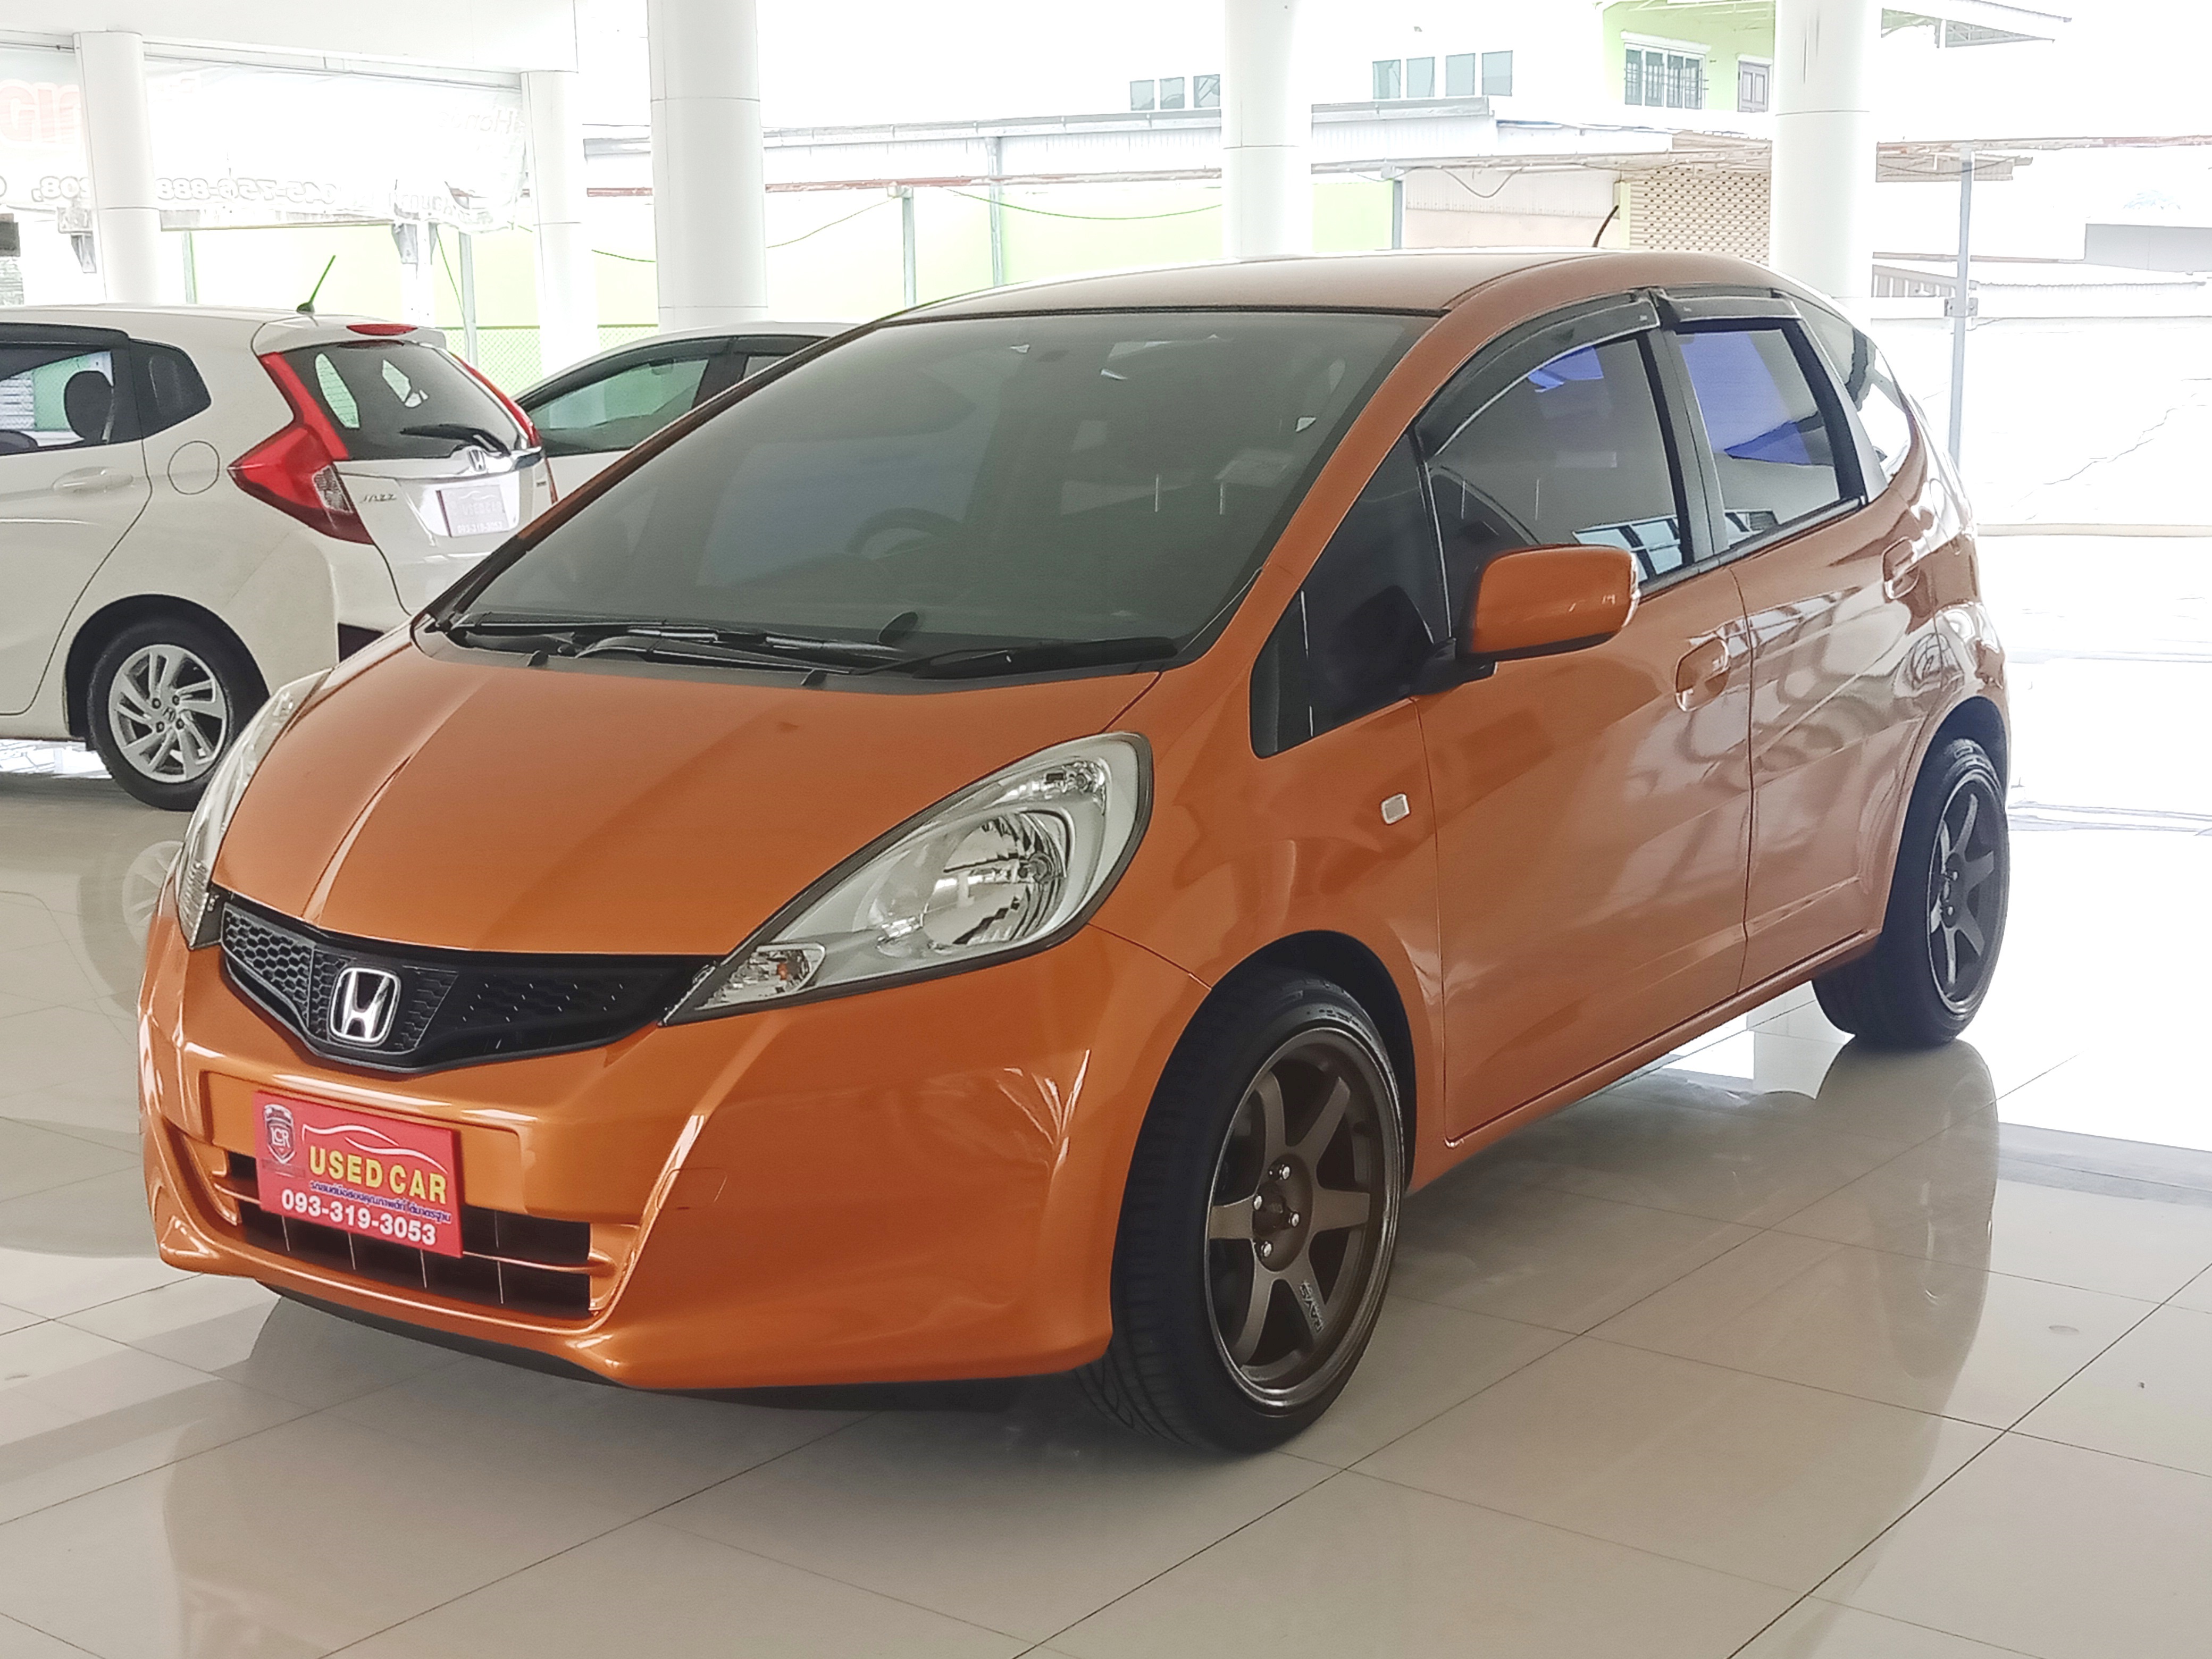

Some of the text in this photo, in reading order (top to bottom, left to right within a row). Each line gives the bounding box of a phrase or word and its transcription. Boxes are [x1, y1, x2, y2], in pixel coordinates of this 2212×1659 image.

[309, 1145, 383, 1188] USED
[389, 1164, 446, 1204] CAR
[281, 1188, 436, 1245] 093-319-3053
